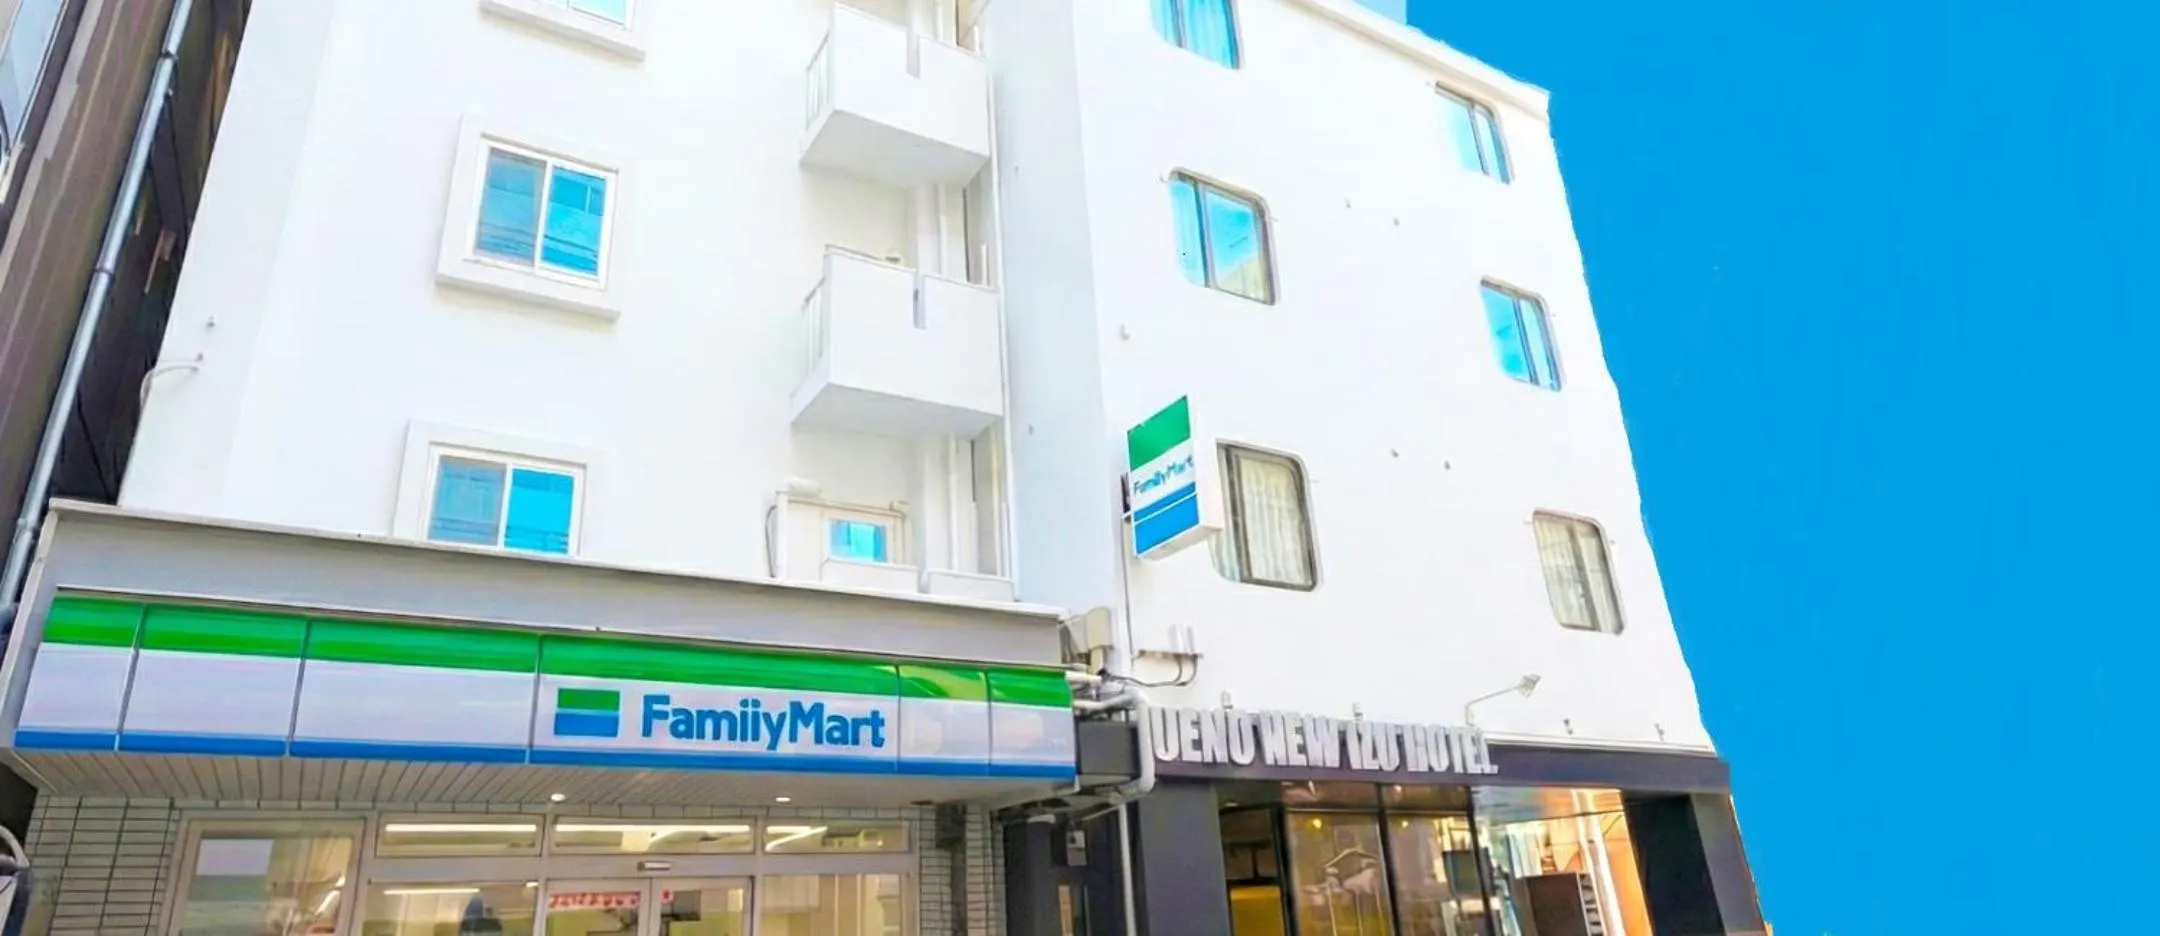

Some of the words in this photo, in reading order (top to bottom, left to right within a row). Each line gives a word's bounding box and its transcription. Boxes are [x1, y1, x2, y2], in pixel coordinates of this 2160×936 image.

[1150, 707, 1256, 766] UENO
[1260, 711, 1340, 768] NEW
[1401, 723, 1499, 775] HOTEL
